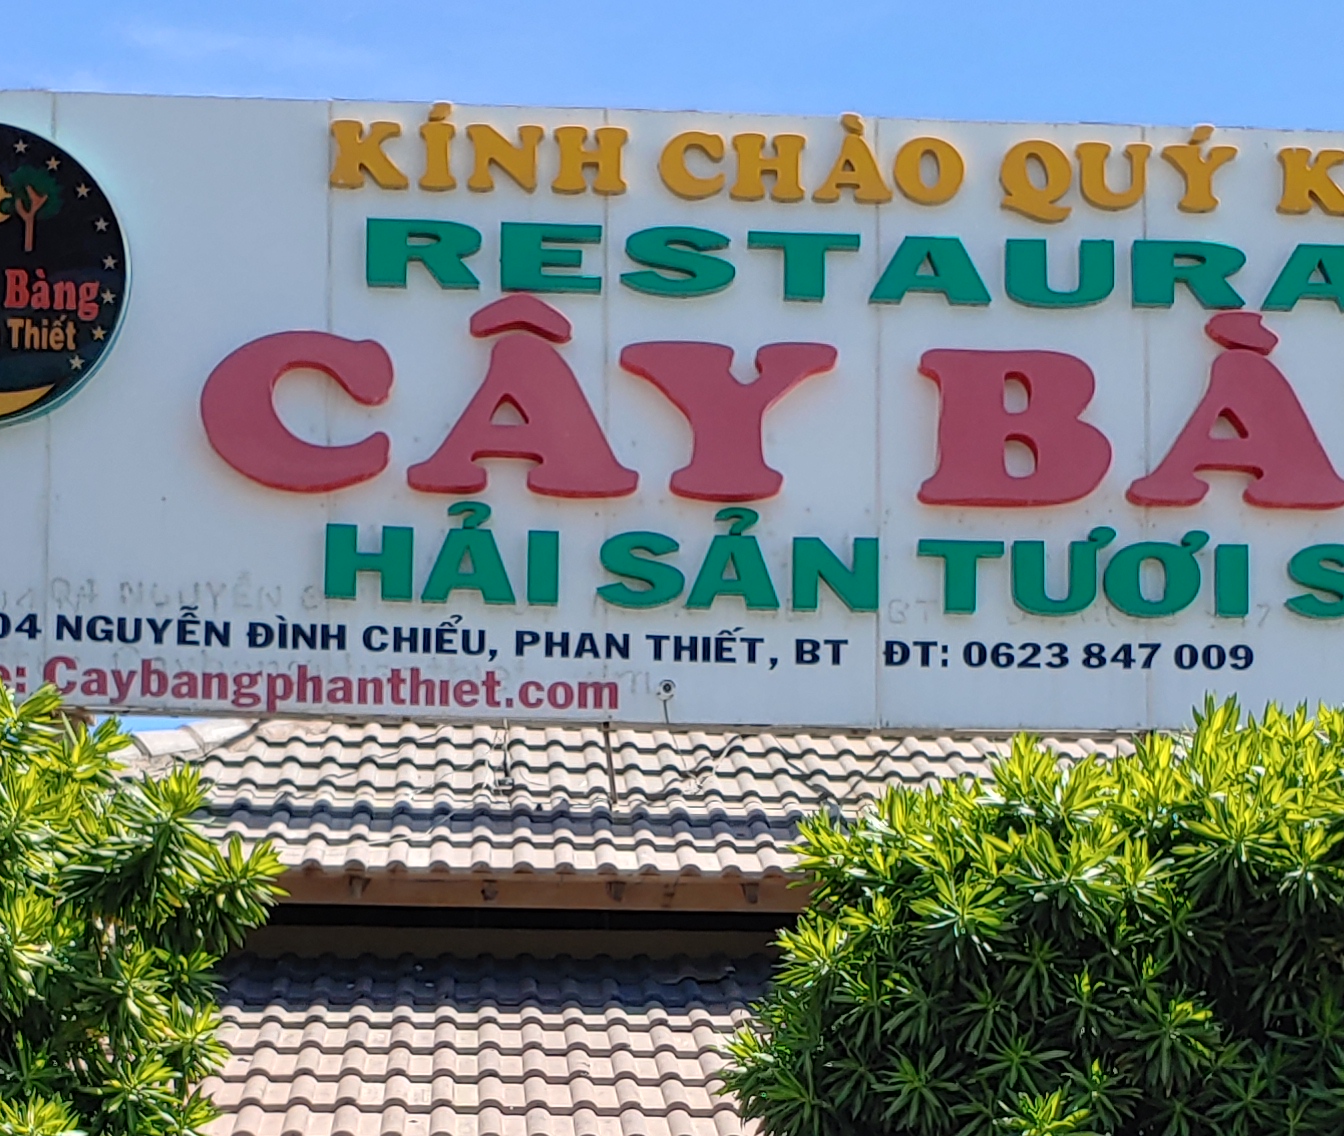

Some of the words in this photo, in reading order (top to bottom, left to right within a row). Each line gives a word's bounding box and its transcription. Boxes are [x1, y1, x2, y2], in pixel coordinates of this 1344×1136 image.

[330, 102, 628, 196] KÍNH
[660, 112, 965, 204] CHÀO
[1001, 124, 1237, 223] QUÝ
[4, 268, 100, 321] Bàng
[8, 314, 76, 350] Thiết
[202, 290, 838, 505] CÂY
[323, 500, 560, 605] HẢI
[596, 507, 880, 612] SẢN
[917, 525, 1250, 618] TƯƠI
[56, 605, 231, 648] NGUYỄN
[246, 615, 346, 651] ĐÌNH
[362, 614, 498, 662] CHIỂU,
[515, 630, 630, 660] PHAN
[645, 626, 778, 671] THIẾT,
[795, 638, 849, 666] BT
[882, 640, 948, 668] ĐT:
[962, 641, 1069, 669] 0623
[1081, 642, 1161, 669] 847
[1174, 643, 1254, 671] 009
